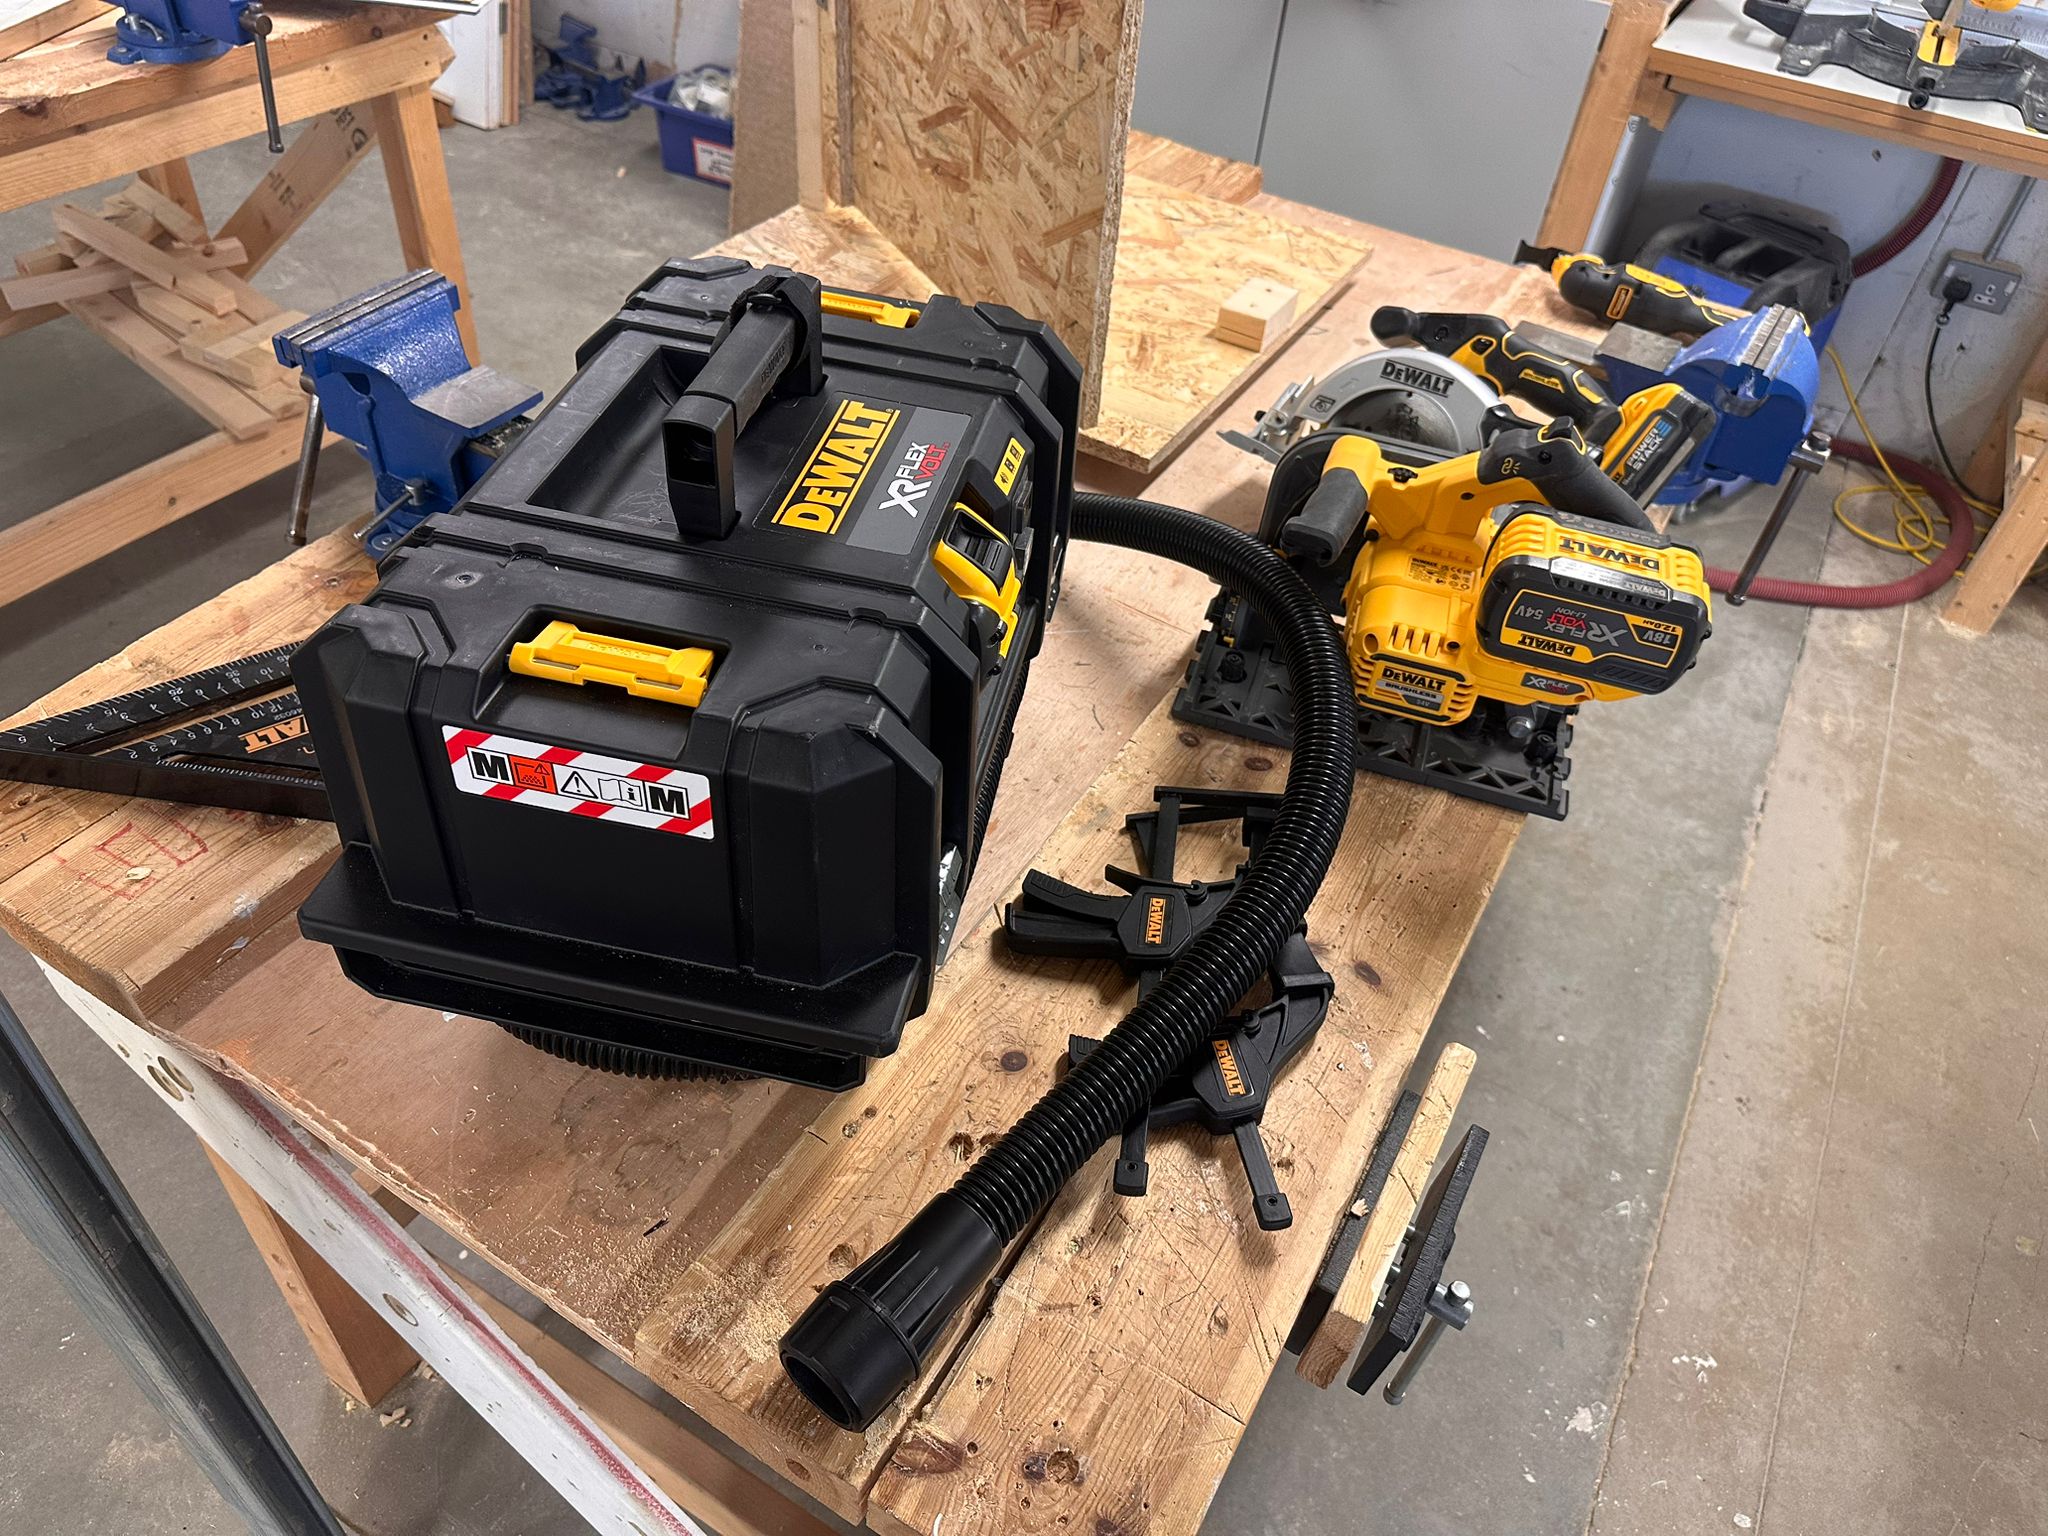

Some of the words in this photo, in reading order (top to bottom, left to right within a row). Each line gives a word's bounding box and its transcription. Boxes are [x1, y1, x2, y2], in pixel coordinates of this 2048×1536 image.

[1380, 360, 1454, 396] DEWALT
[1625, 426, 1658, 467] POWER
[1632, 435, 1665, 470] STACK
[779, 401, 893, 534] DEWALT
[895, 442, 930, 480] FLEX
[914, 443, 947, 480] VOLT
[878, 479, 932, 518] XR
[1559, 535, 1660, 572] DEWALT
[1624, 581, 1667, 598] DEWALT
[1515, 605, 1543, 620] 54V
[1555, 606, 1587, 618] LI-ION
[1544, 620, 1586, 639] FLEX
[1547, 613, 1586, 631] VOLT
[1587, 621, 1628, 647] XR
[1643, 630, 1672, 645] 18V
[1518, 634, 1576, 657] DEWALT
[225, 670, 241, 679] 35
[260, 666, 274, 675] 10
[1382, 667, 1446, 691] DEWALT
[1526, 676, 1547, 689] XR
[168, 687, 184, 697] 25
[104, 707, 119, 717] 15
[251, 709, 266, 719] 10
[269, 703, 283, 713] 12
[85, 722, 94, 731] 2
[218, 722, 227, 731] 7
[231, 717, 241, 726] 8
[187, 732, 196, 740] 5
[203, 726, 213, 735] 6
[18, 735, 27, 744] 5
[47, 735, 54, 743] 1
[128, 750, 138, 760] 2
[149, 744, 159, 753] 3
[471, 751, 510, 781] M
[650, 786, 684, 814] M
[1145, 897, 1166, 944] DEWALT
[1212, 1039, 1245, 1096] DEWALT
